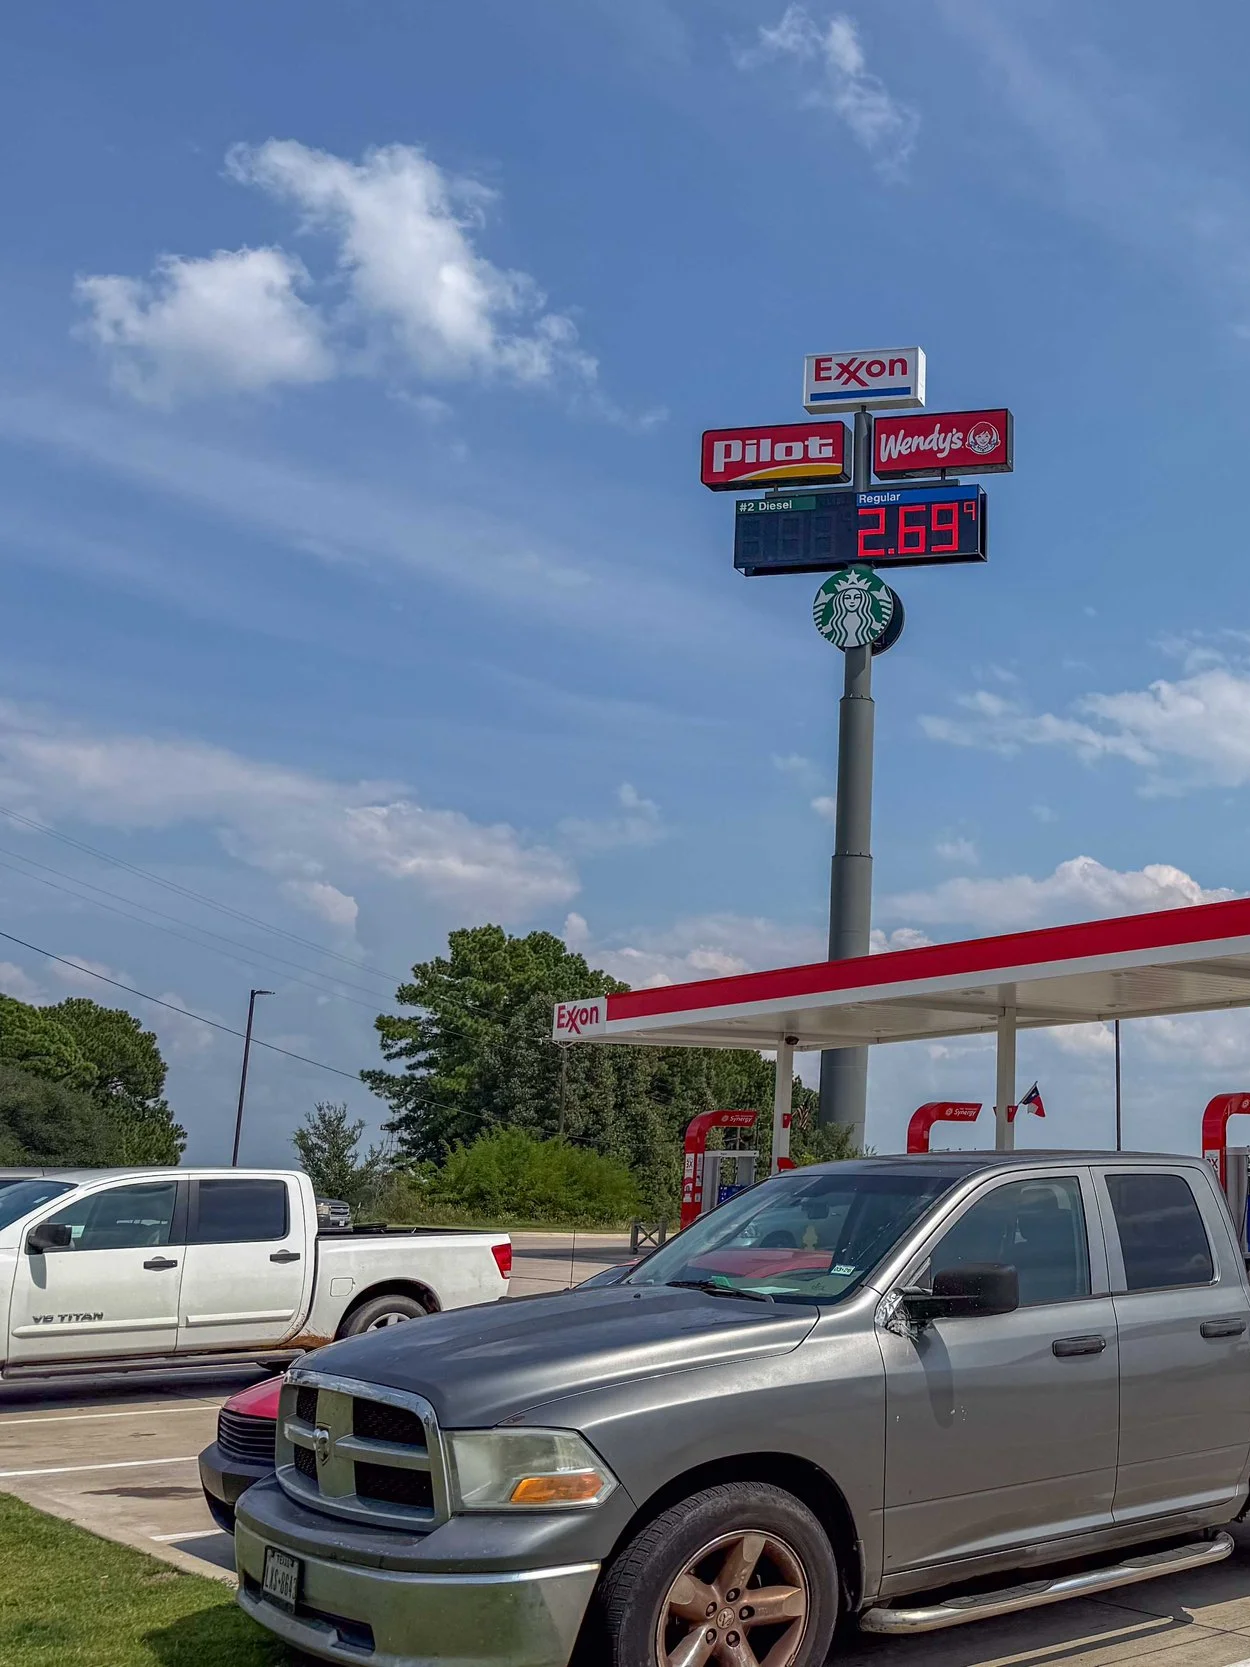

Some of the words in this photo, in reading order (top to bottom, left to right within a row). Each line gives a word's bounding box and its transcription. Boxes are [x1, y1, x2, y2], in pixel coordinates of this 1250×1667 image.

[814, 356, 908, 387] Exxon
[879, 423, 964, 463] Wendy's
[712, 436, 834, 473] Pilot
[738, 501, 755, 513] #2
[758, 499, 793, 512] Diesel
[858, 492, 901, 505] Regular
[857, 502, 959, 557] 2.69
[556, 1004, 599, 1035] Exxon
[729, 1115, 753, 1123] Synergy
[953, 1108, 977, 1117] Synergy
[57, 1312, 104, 1323] TITAN
